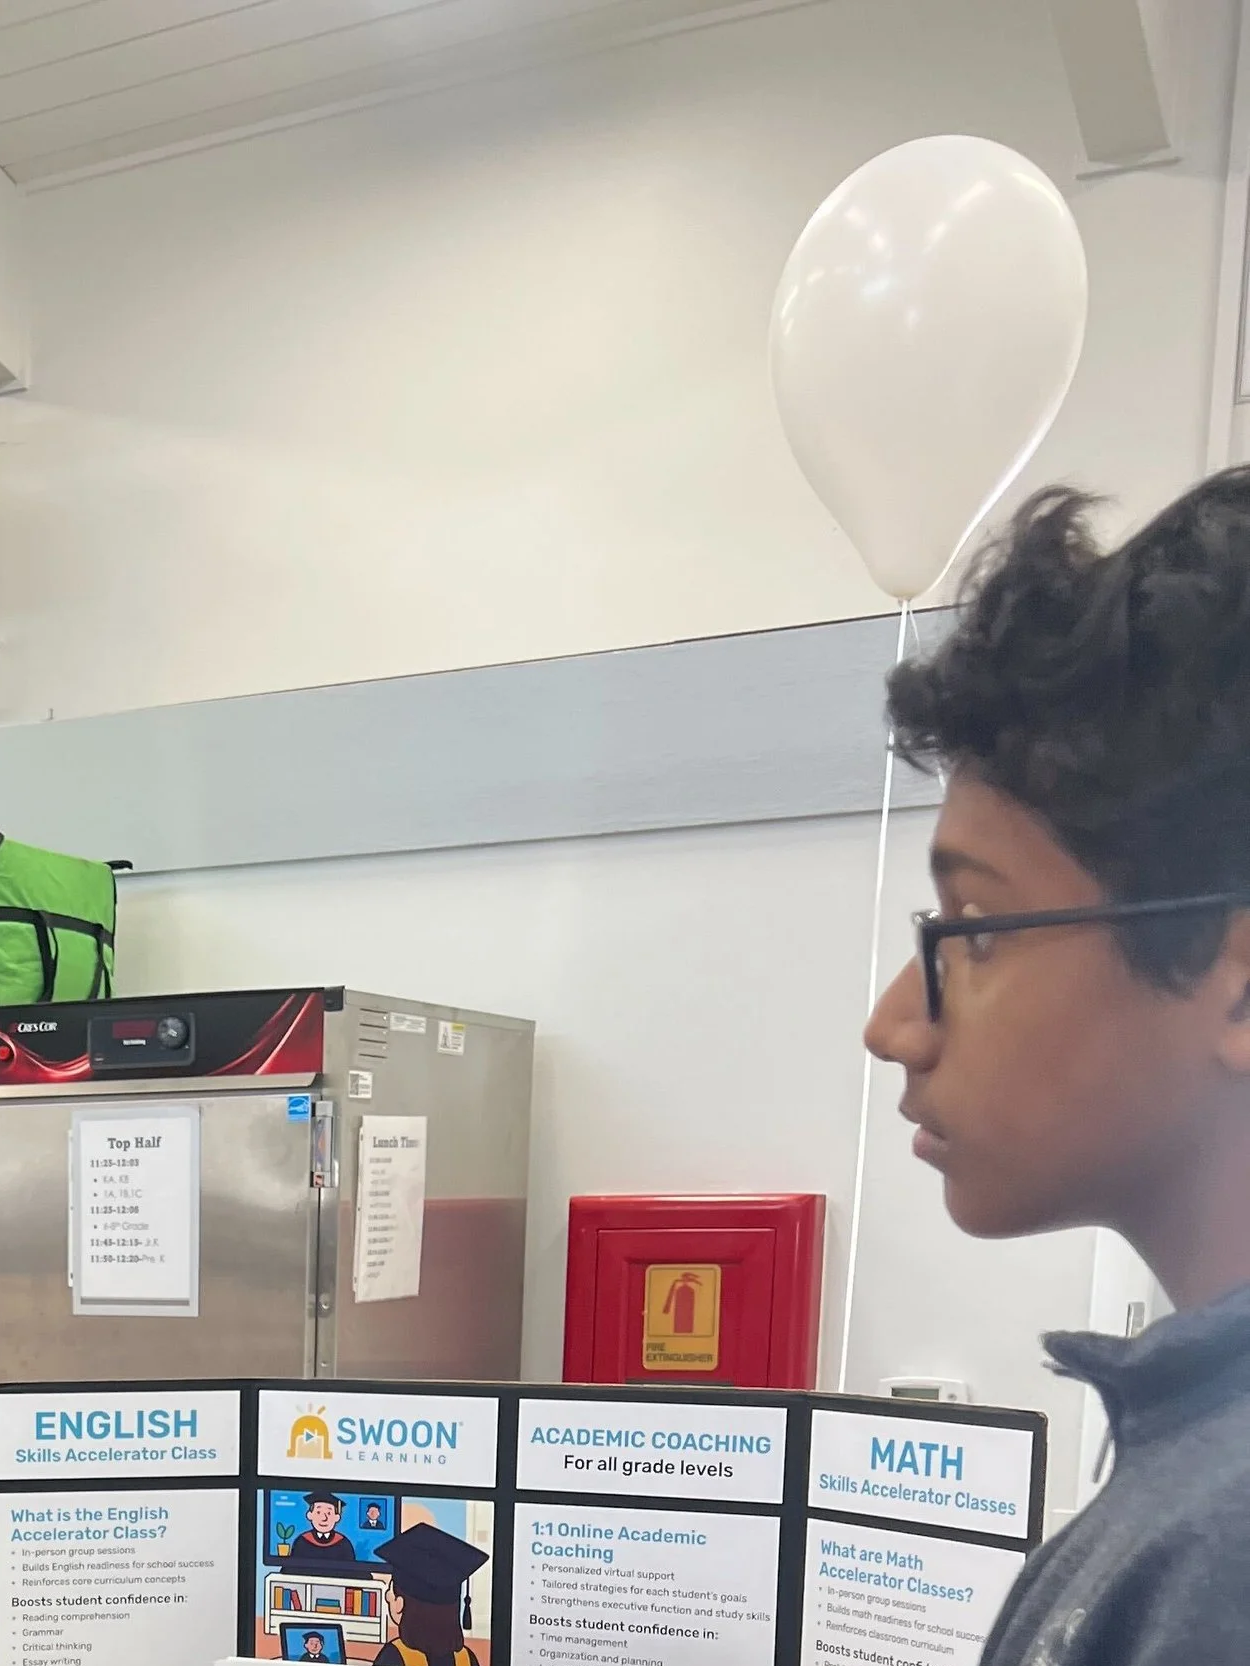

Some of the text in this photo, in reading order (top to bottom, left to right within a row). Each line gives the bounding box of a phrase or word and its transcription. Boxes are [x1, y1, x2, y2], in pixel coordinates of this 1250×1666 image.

[108, 1136, 162, 1151] Top Half
[373, 1137, 398, 1148] Lunch
[646, 1342, 665, 1351] FIRE
[35, 1409, 197, 1440] ENGLISH
[337, 1417, 457, 1449] SWOON
[531, 1427, 771, 1454] ACADEMIC COACHING
[16, 1446, 216, 1463] Skills Accelerator Class
[346, 1451, 446, 1464] LEARNING
[871, 1437, 963, 1480] MATH
[564, 1455, 733, 1477] For all grade levels
[820, 1474, 1016, 1516] Skills Accelerator Classes
[11, 1507, 168, 1523] What is the English
[11, 1525, 166, 1542] Accelerator Class?
[531, 1521, 706, 1545] 1:1 Online Academic
[22, 1546, 135, 1558] In-person group sessions
[531, 1541, 614, 1563] Coaching
[821, 1539, 923, 1571] What are Math
[22, 1560, 214, 1573] Builds English readiness for school success
[542, 1563, 675, 1582] Personalized virtual support
[22, 1577, 70, 1587] Reinforces
[94, 1576, 142, 1585] curriculum
[145, 1575, 185, 1585] concepts
[819, 1562, 973, 1601] Accelerator Classes?
[11, 1594, 188, 1607] Boosts student confidence in:
[542, 1579, 747, 1603] Tailored strategies for each student's goals
[827, 1586, 926, 1613] In-person group sessions
[22, 1612, 130, 1623] Reading comprehension
[541, 1595, 771, 1622] Strengthens executive function and study skills
[22, 1628, 64, 1637] Grammar
[529, 1614, 719, 1640] Boosts student confidence in:
[827, 1603, 986, 1643] Builds math readiness for school succes
[23, 1642, 92, 1652] Critical thinking
[540, 1632, 628, 1648] Time management
[826, 1620, 954, 1655] Reinforces classroom curriculum
[23, 1657, 81, 1666] Essay writing
[539, 1649, 598, 1662] Organization
[601, 1654, 619, 1664] and
[816, 1640, 851, 1657] Boosts
[853, 1648, 894, 1666] student
